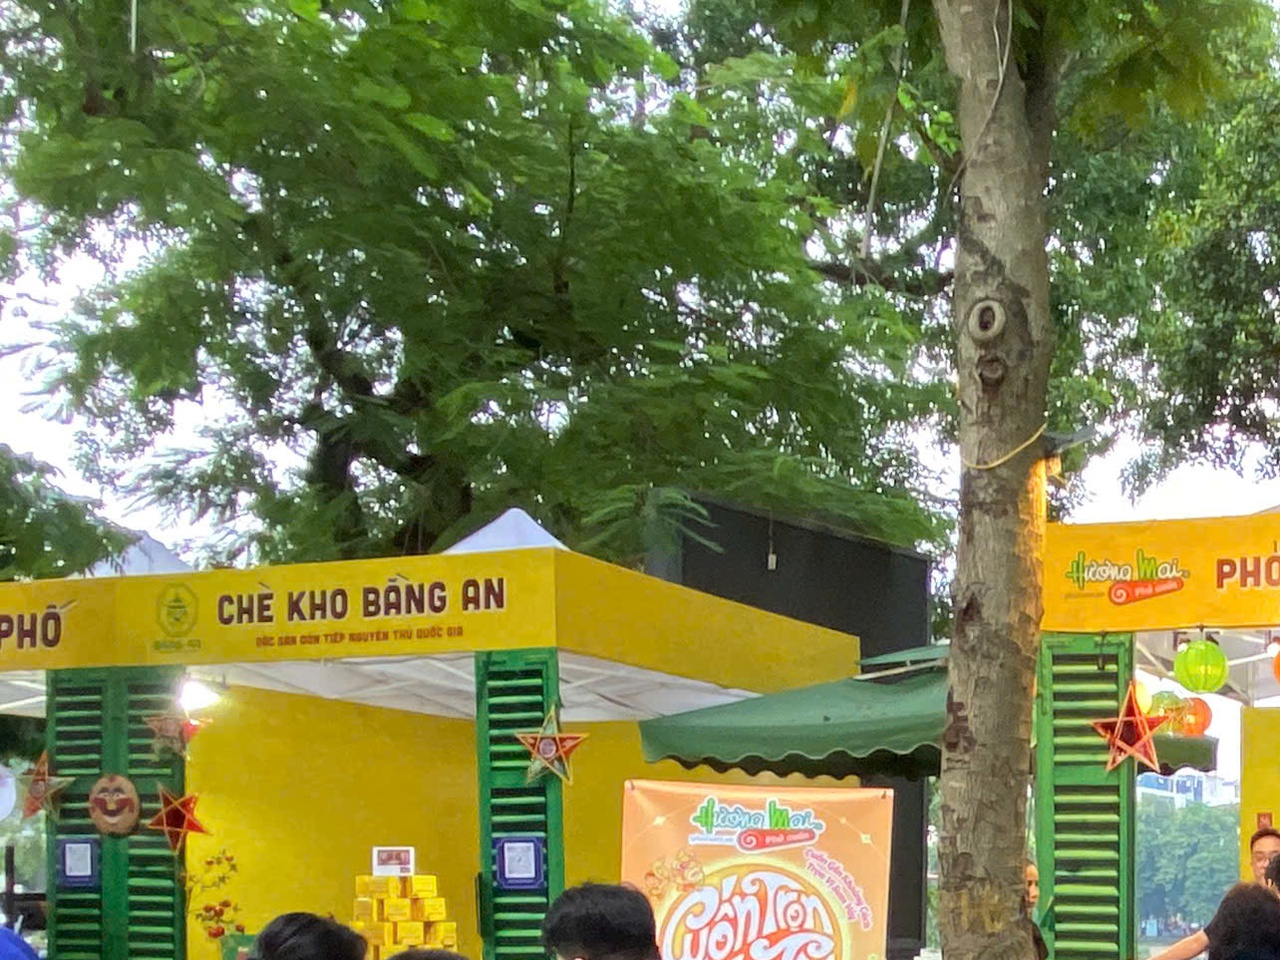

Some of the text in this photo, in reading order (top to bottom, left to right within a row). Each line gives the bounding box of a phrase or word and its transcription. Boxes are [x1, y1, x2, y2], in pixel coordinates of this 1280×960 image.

[0, 600, 76, 650] PHỐ
[217, 582, 275, 625] CHÈ
[287, 588, 348, 623] KHO
[461, 577, 505, 611] AN
